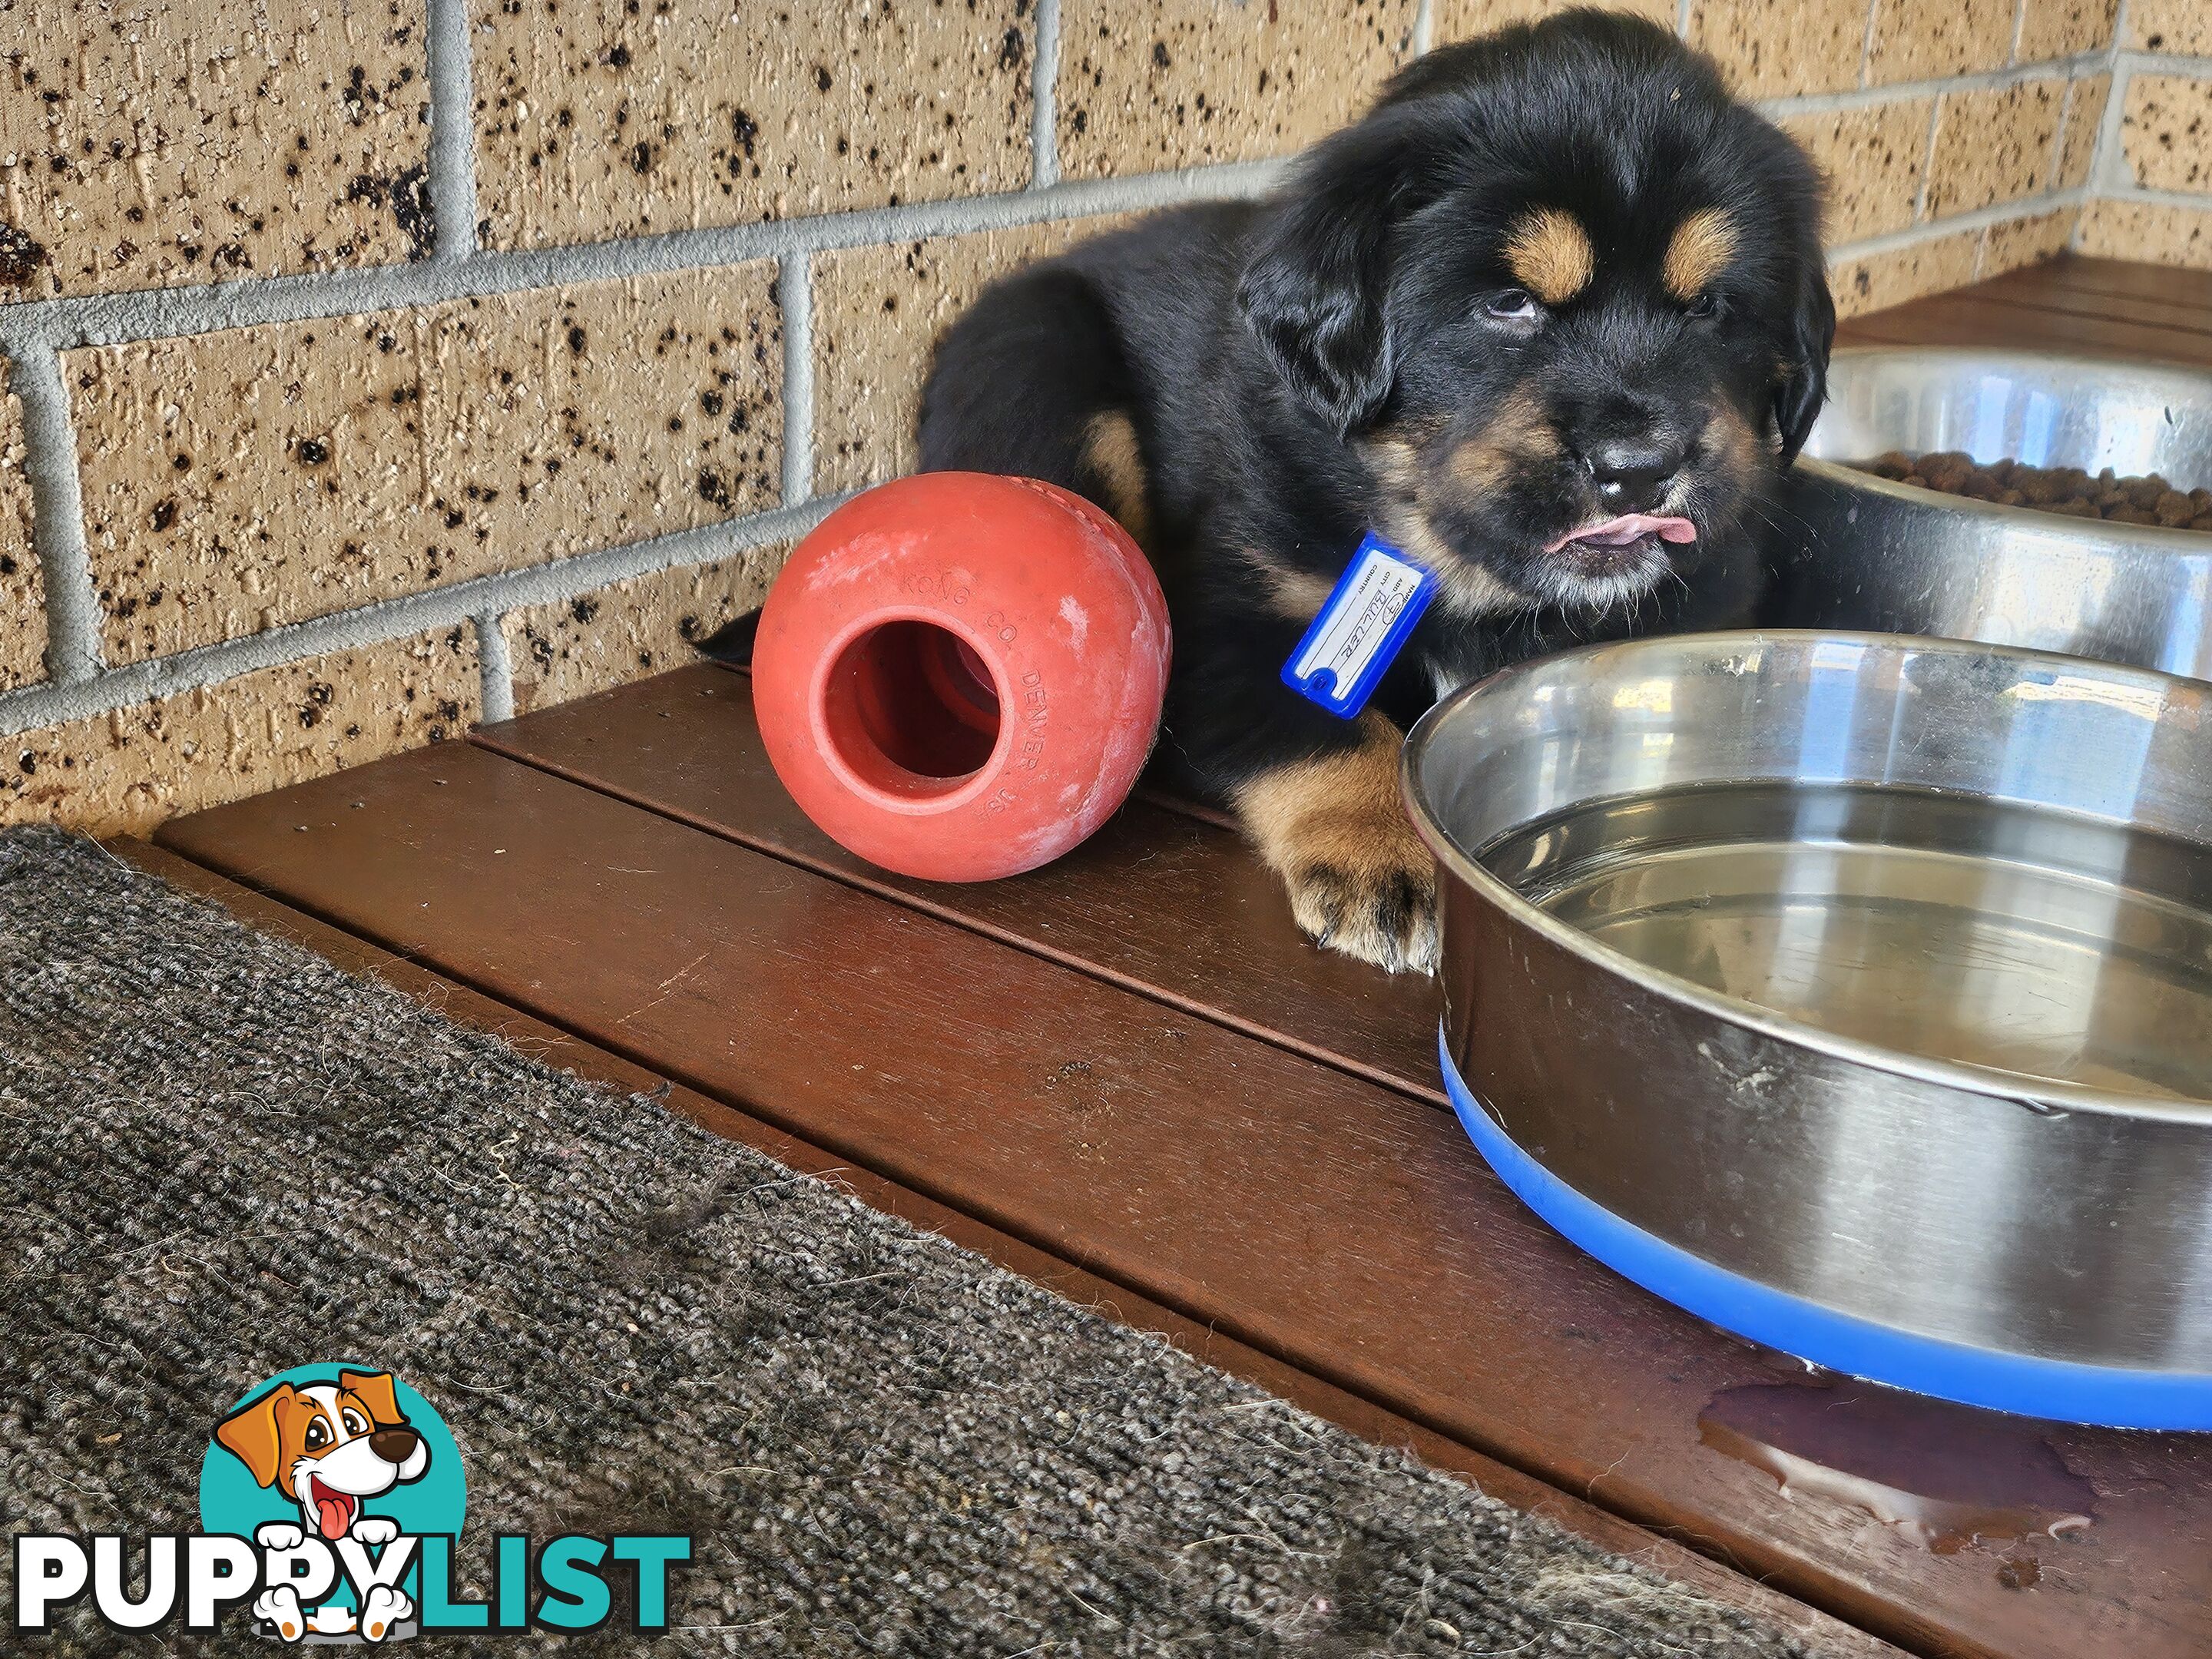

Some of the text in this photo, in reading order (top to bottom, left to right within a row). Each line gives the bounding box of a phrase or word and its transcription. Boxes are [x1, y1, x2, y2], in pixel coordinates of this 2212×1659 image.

[1358, 564, 1378, 595] COUNTRY
[1380, 571, 1391, 587] CITY
[899, 571, 970, 605] KONG
[1020, 668, 1048, 770] DENVER
